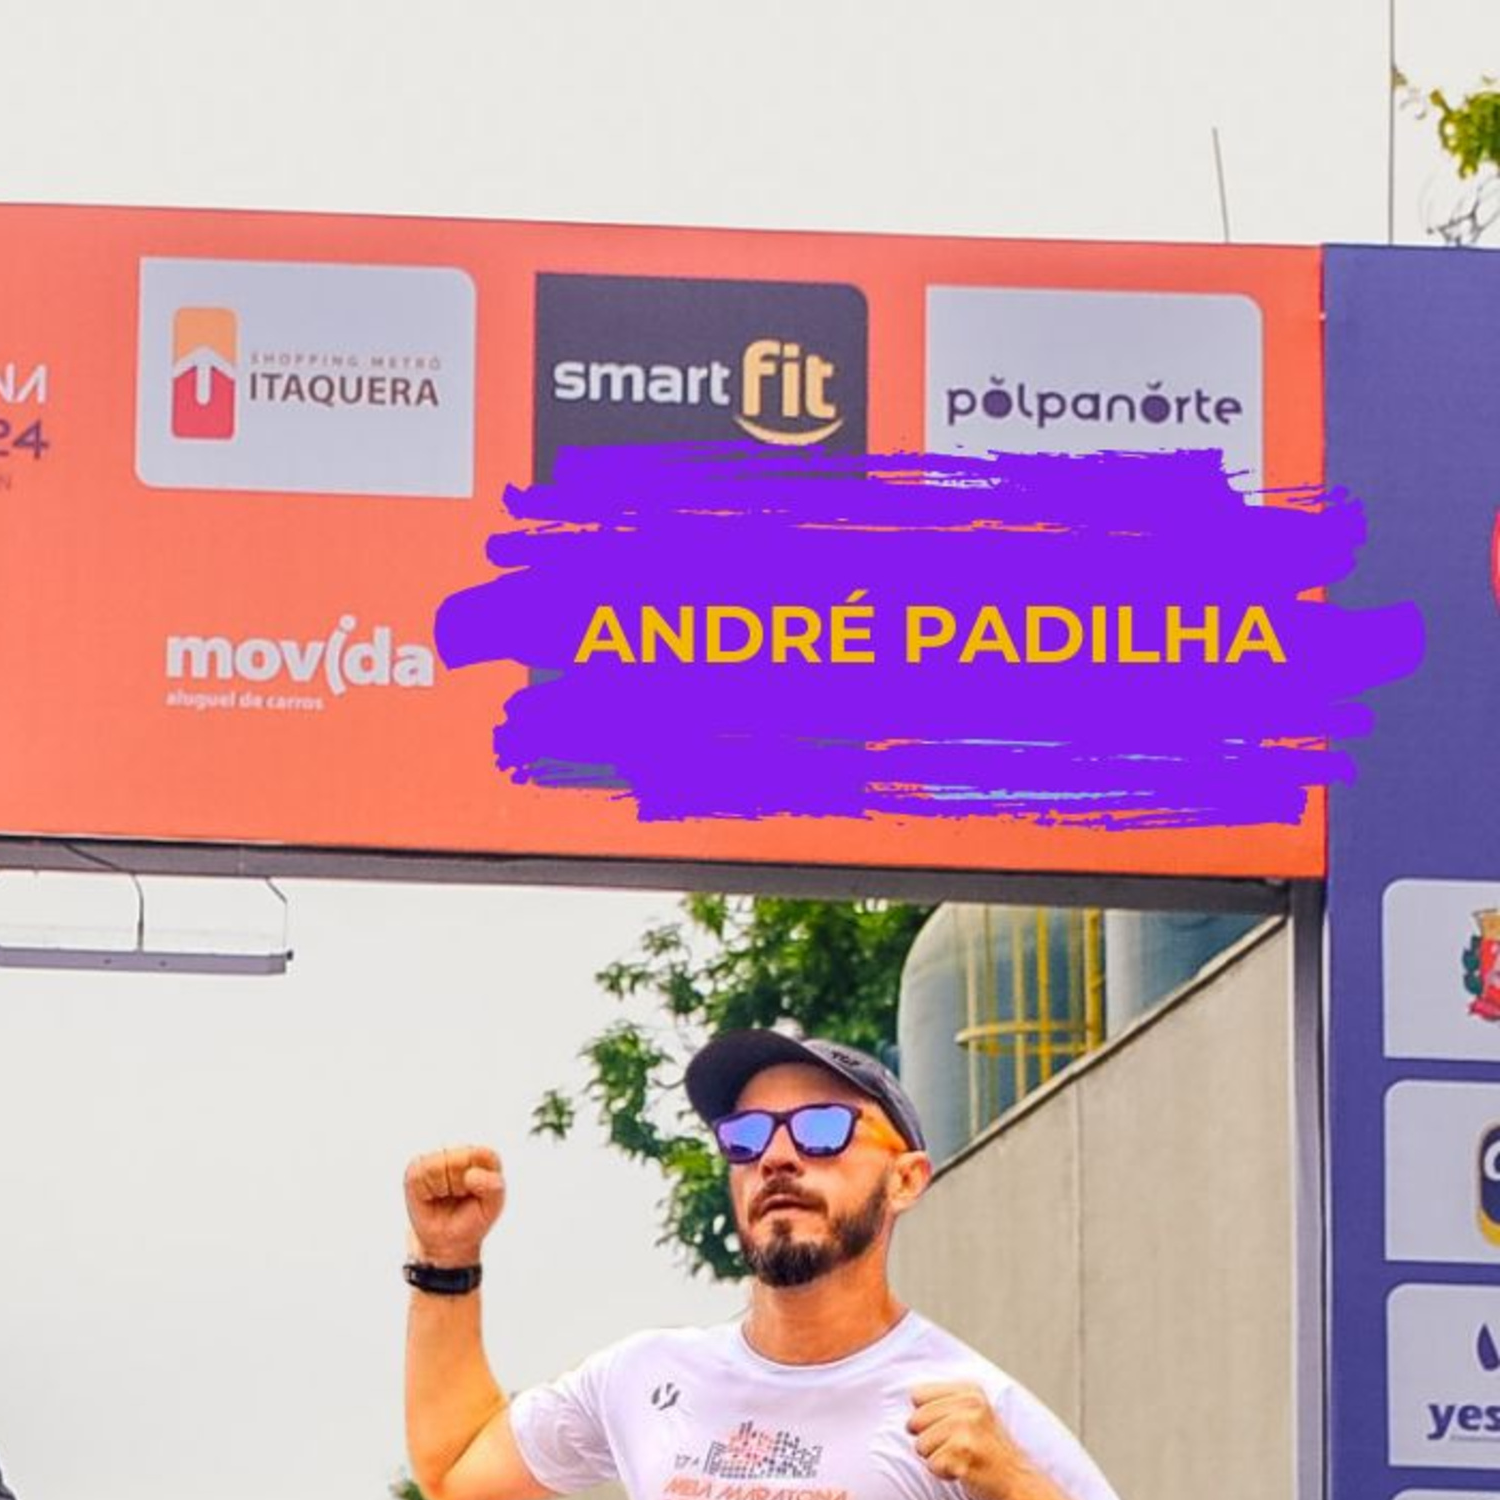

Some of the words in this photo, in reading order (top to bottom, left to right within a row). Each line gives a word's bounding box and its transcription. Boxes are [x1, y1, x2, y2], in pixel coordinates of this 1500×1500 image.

[250, 352, 360, 368] SHOPPING
[249, 371, 440, 408] ITAQUERA
[553, 360, 731, 406] smart
[742, 339, 836, 419] fit
[166, 690, 236, 711] aluguel
[265, 694, 326, 712] carros
